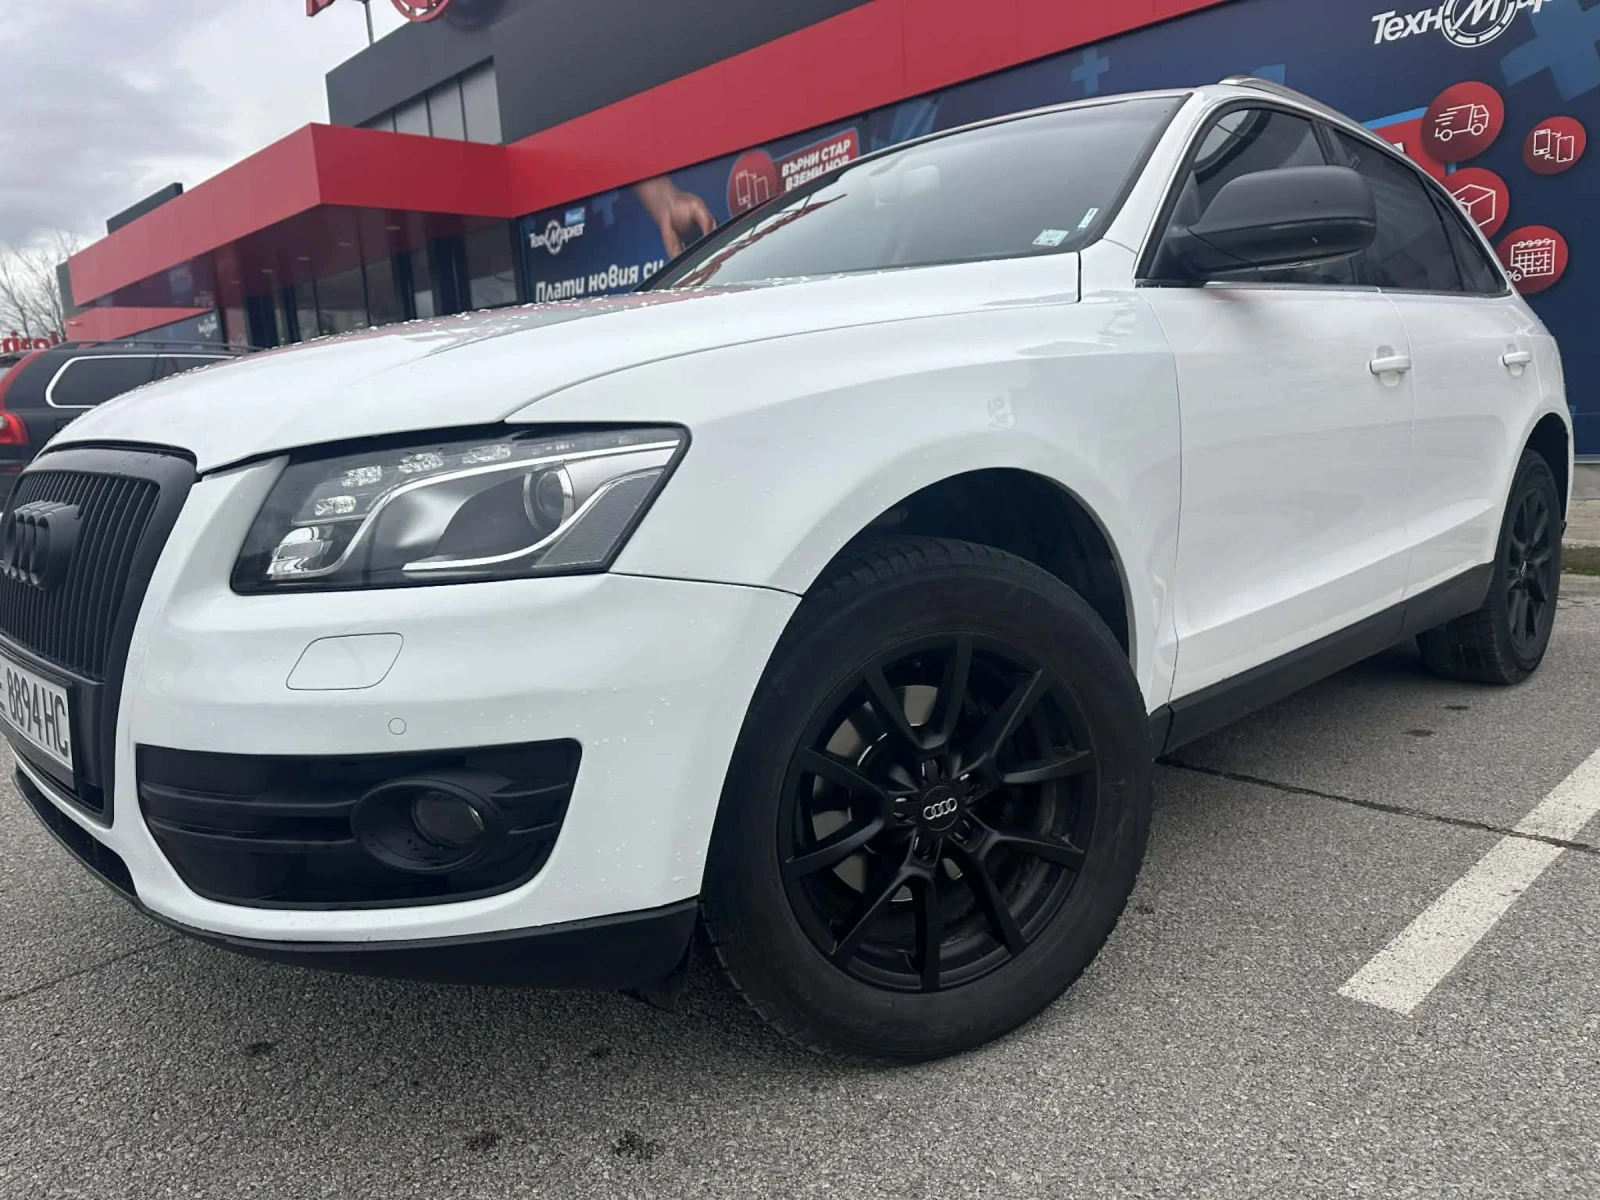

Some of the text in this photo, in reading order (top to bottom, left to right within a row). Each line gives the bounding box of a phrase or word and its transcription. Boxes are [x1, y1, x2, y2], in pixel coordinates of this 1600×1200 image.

[782, 139, 851, 177] ВЪРНИ СТАР
[785, 165, 825, 191] ВЗЕМИ
[536, 278, 584, 302] Плати
[588, 264, 639, 291] новия
